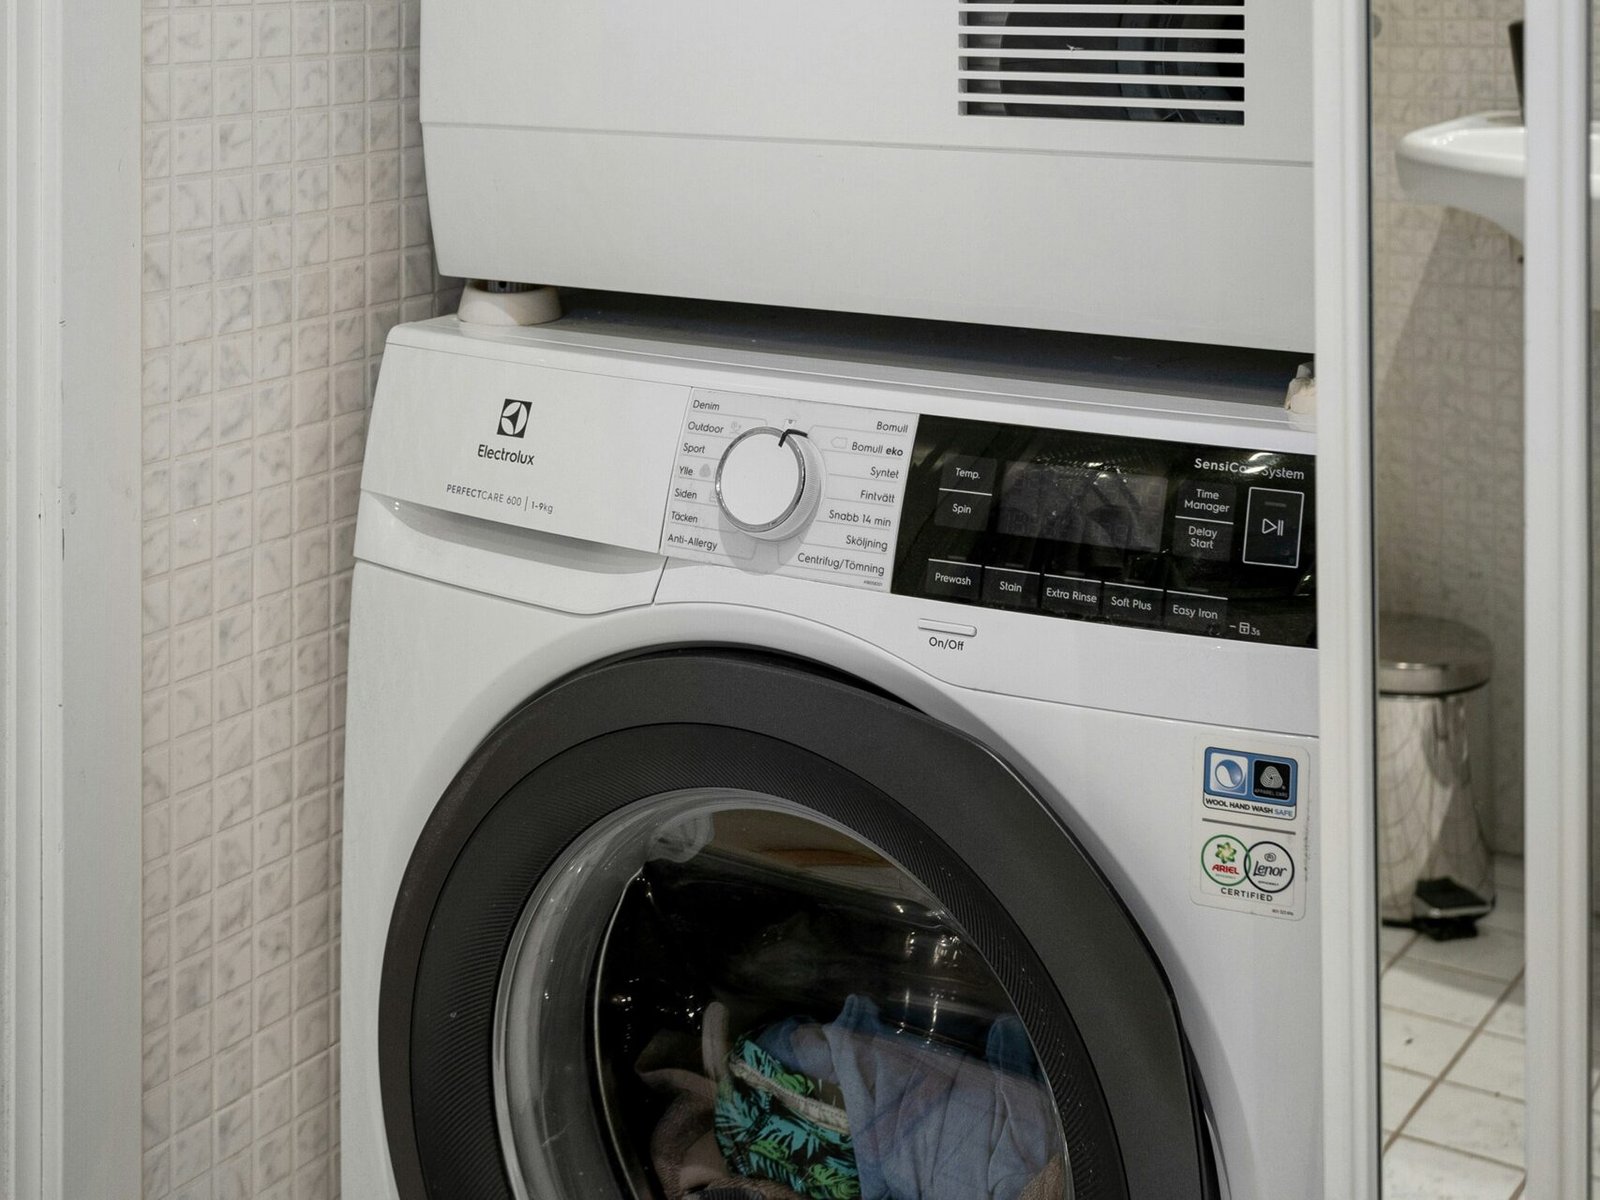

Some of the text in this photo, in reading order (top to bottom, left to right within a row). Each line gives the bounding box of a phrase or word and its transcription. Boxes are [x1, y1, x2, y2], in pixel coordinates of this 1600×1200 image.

[692, 399, 720, 411] Denim
[687, 421, 725, 433] Outdoor
[876, 421, 909, 433] Bomull
[477, 444, 535, 465] Electrolux
[682, 442, 706, 454] Sport
[852, 442, 904, 457] Bomull eko
[679, 465, 694, 476] Ylle
[870, 466, 899, 479] Syntet
[955, 467, 981, 480] Temp.
[446, 484, 504, 503] PERFECTCARE
[506, 495, 522, 507] 600
[674, 488, 698, 500] Siden
[860, 490, 895, 504] Fintvätt
[1196, 489, 1220, 500] Time
[952, 503, 972, 515] Spin
[1184, 500, 1230, 513] Manager
[829, 509, 892, 527] Snabb 14 min
[1188, 526, 1218, 540] Delay
[667, 533, 718, 551] Anti-Allergy
[846, 535, 888, 553] Sköljning
[1190, 538, 1214, 550] Start
[797, 552, 885, 577] Centrifug/Tömning
[934, 572, 972, 586] Prewash
[999, 581, 1022, 593] Stain
[1046, 588, 1098, 603] Extra Rinse
[1111, 596, 1152, 611] Soft Plus
[1172, 604, 1218, 620] Easy Iron
[1251, 627, 1261, 636] 3s
[928, 636, 964, 651] On/Off
[1205, 798, 1293, 817] WOOL HAND WASH SAFE
[1211, 864, 1240, 875] ARIEL
[1253, 860, 1288, 877] Lenor
[1220, 887, 1274, 902] CERTIFIED
